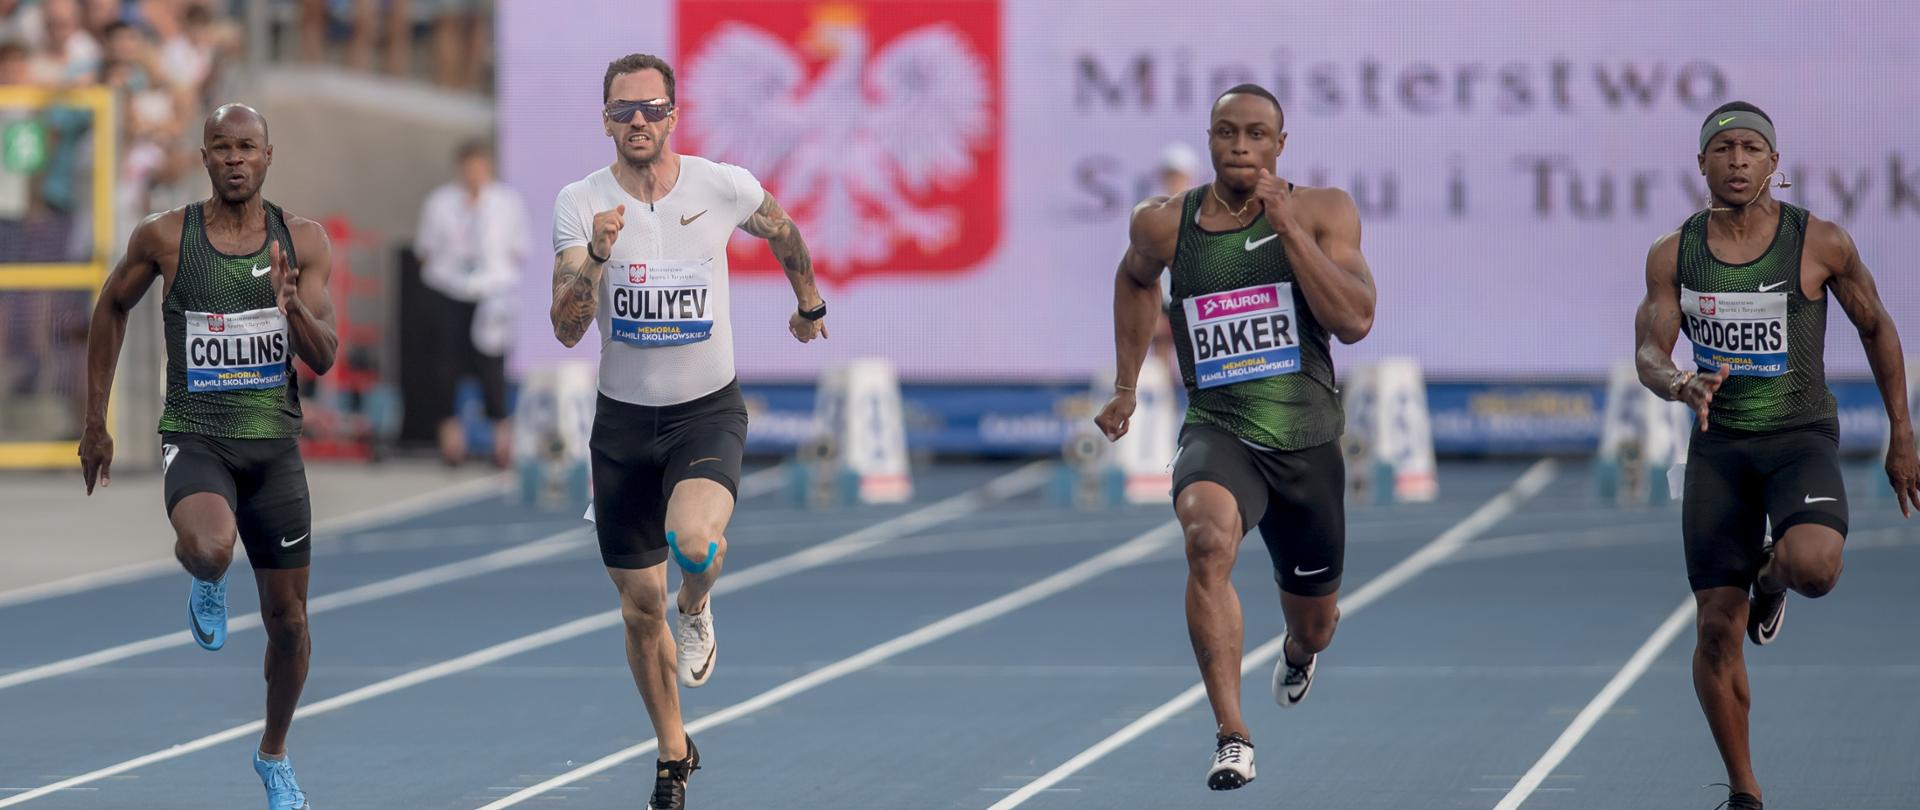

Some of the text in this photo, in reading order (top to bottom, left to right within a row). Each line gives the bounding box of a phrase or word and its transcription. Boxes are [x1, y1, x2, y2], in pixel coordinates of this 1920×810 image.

[1513, 152, 1920, 230] Turtyk
[613, 288, 707, 319] GULIYEV
[1218, 293, 1271, 310] TAURON
[616, 330, 706, 340] KAMILI SKOLIMOWSKIEJ
[1194, 314, 1294, 361] BAKER
[1689, 315, 1782, 351] RODGERS
[191, 333, 284, 367] COLLINS
[1201, 360, 1295, 382] KAMILI SKOLIMOWSKIEJ
[1716, 360, 1780, 371] SLIMOWSKIEJ
[194, 375, 283, 388] KAMILI SKOLIMOWSKIEJ
